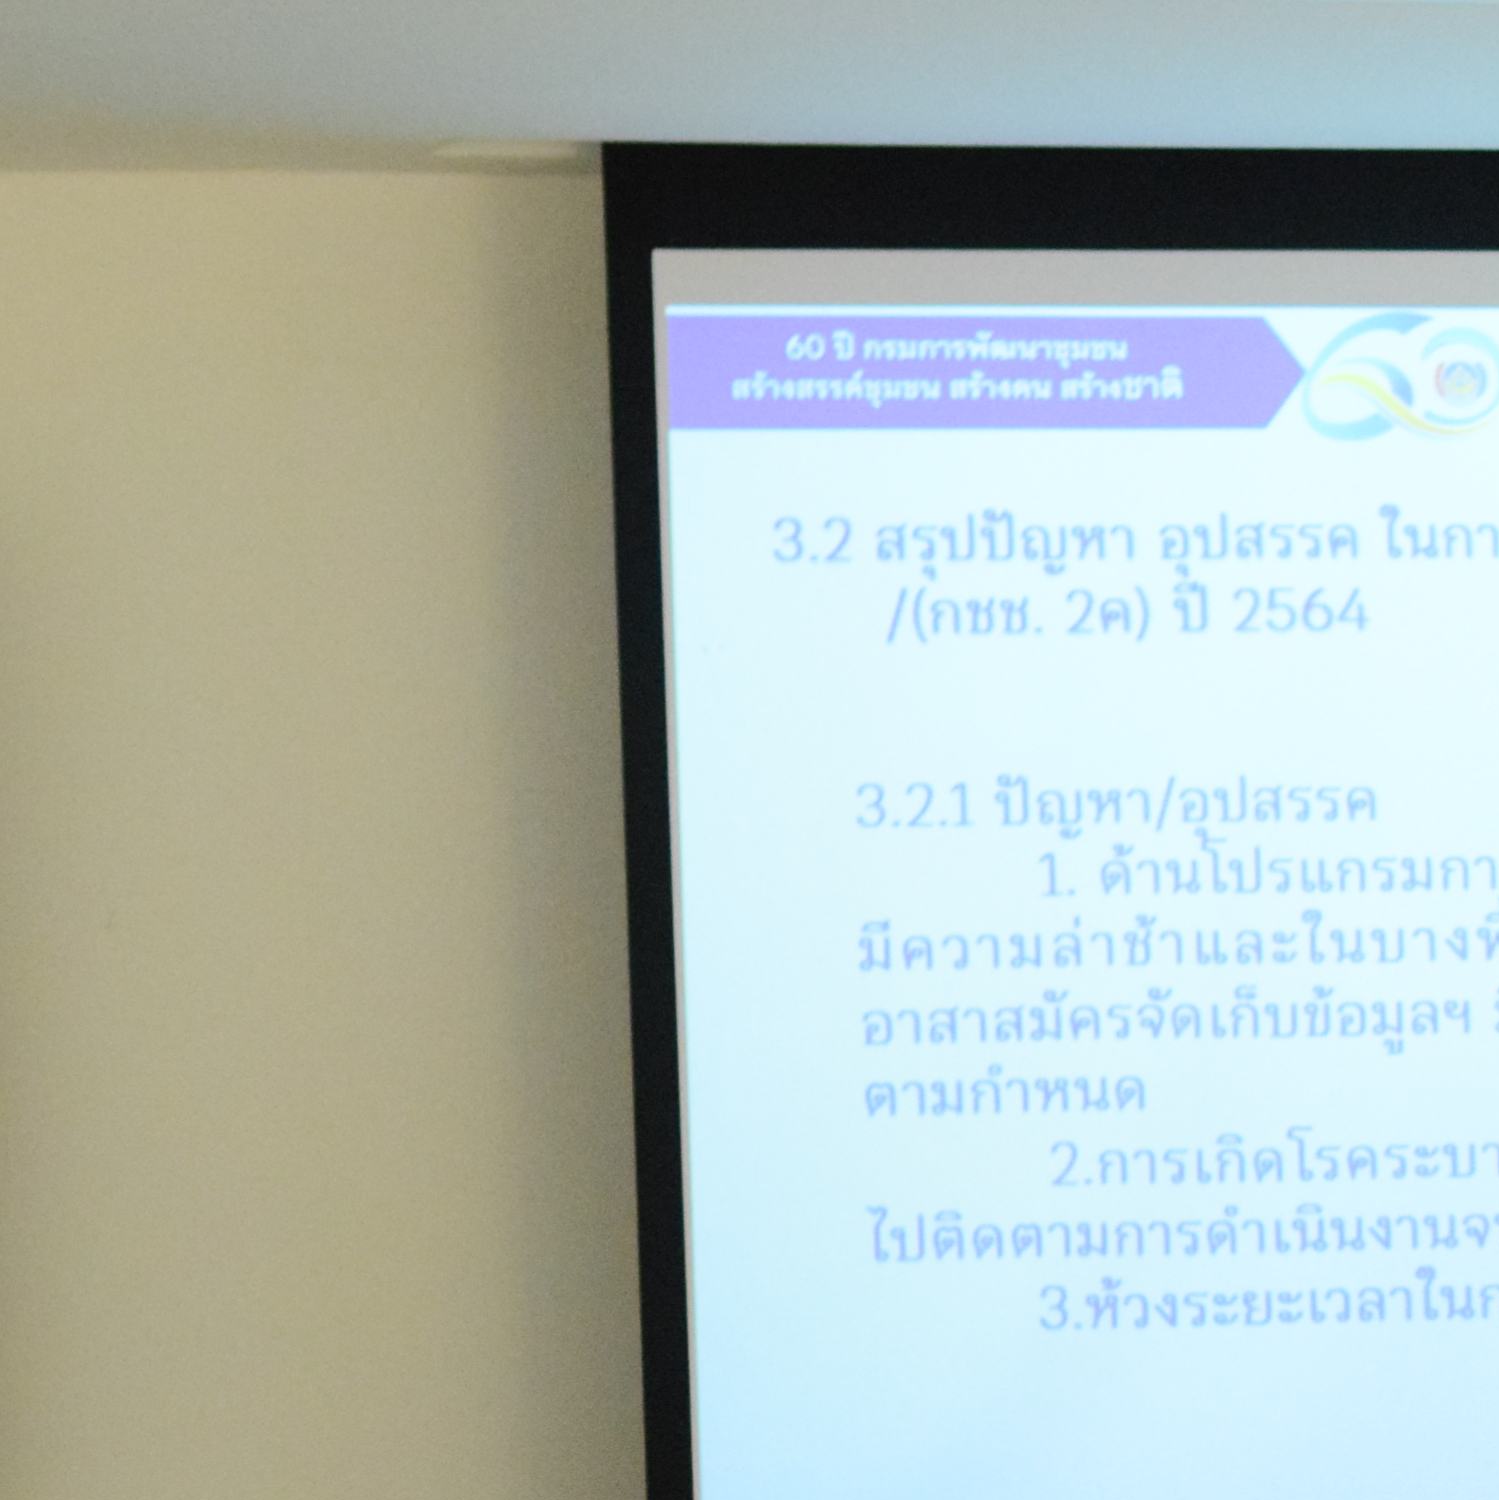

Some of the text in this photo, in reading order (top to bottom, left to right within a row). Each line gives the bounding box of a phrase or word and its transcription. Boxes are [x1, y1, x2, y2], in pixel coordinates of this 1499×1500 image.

[786, 333, 826, 360] 60
[831, 328, 857, 361] ปี
[774, 517, 853, 564] 3.2
[876, 509, 1135, 579] สรุปปัญหา
[1160, 513, 1359, 578] อุปสรรค
[886, 578, 1369, 645] /(กชช. 2ค) ปี 2564
[856, 773, 1378, 842] 3.2.1 ปัญหา/อุปสรรค
[1040, 852, 1075, 897] 1.
